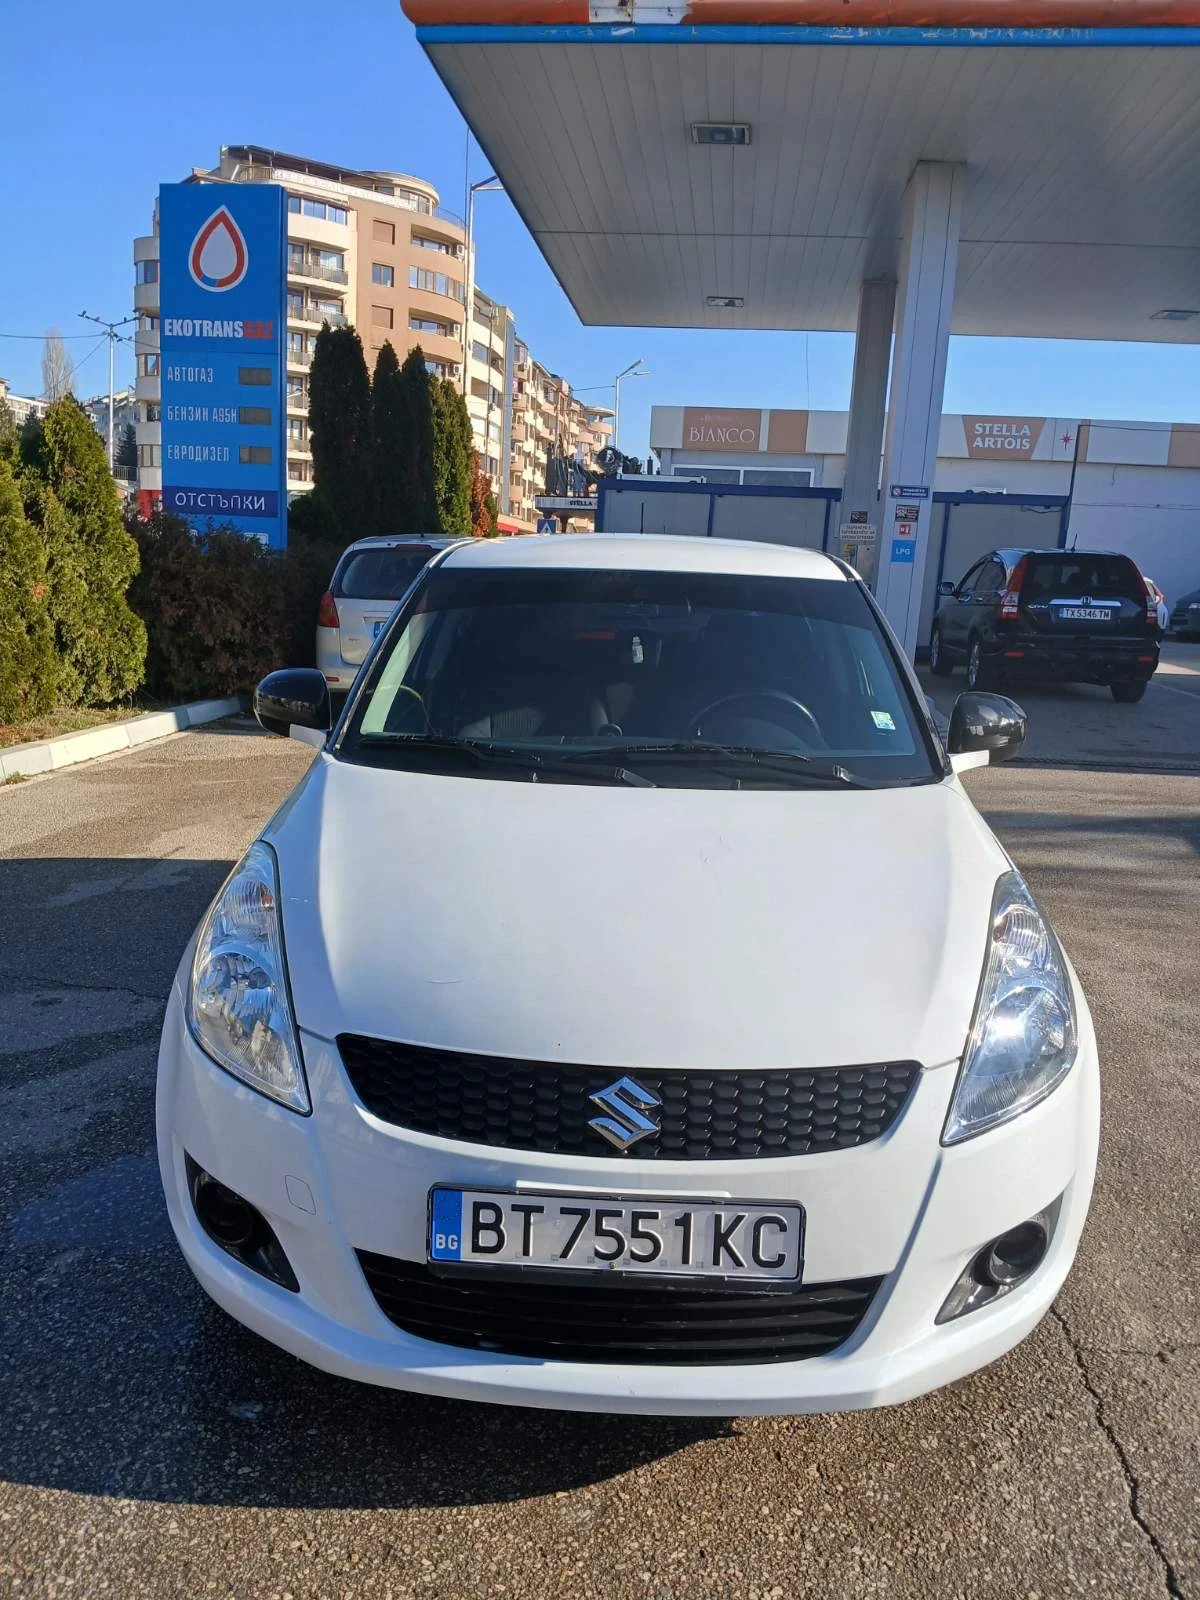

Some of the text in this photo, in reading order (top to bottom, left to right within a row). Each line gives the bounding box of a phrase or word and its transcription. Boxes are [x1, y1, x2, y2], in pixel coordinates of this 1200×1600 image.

[167, 366, 213, 383] АВТОГАЗ
[167, 406, 209, 422] БЕНЗИН
[688, 426, 755, 444] BIANCO
[974, 423, 1031, 436] STELLA
[973, 437, 1031, 449] ARTOIS
[167, 445, 230, 462] ЕВРОДИЗЕЛ
[175, 492, 265, 511] ОТСТЪПКИ
[435, 1234, 459, 1250] BG
[471, 1201, 788, 1269] BT 7551 KC
